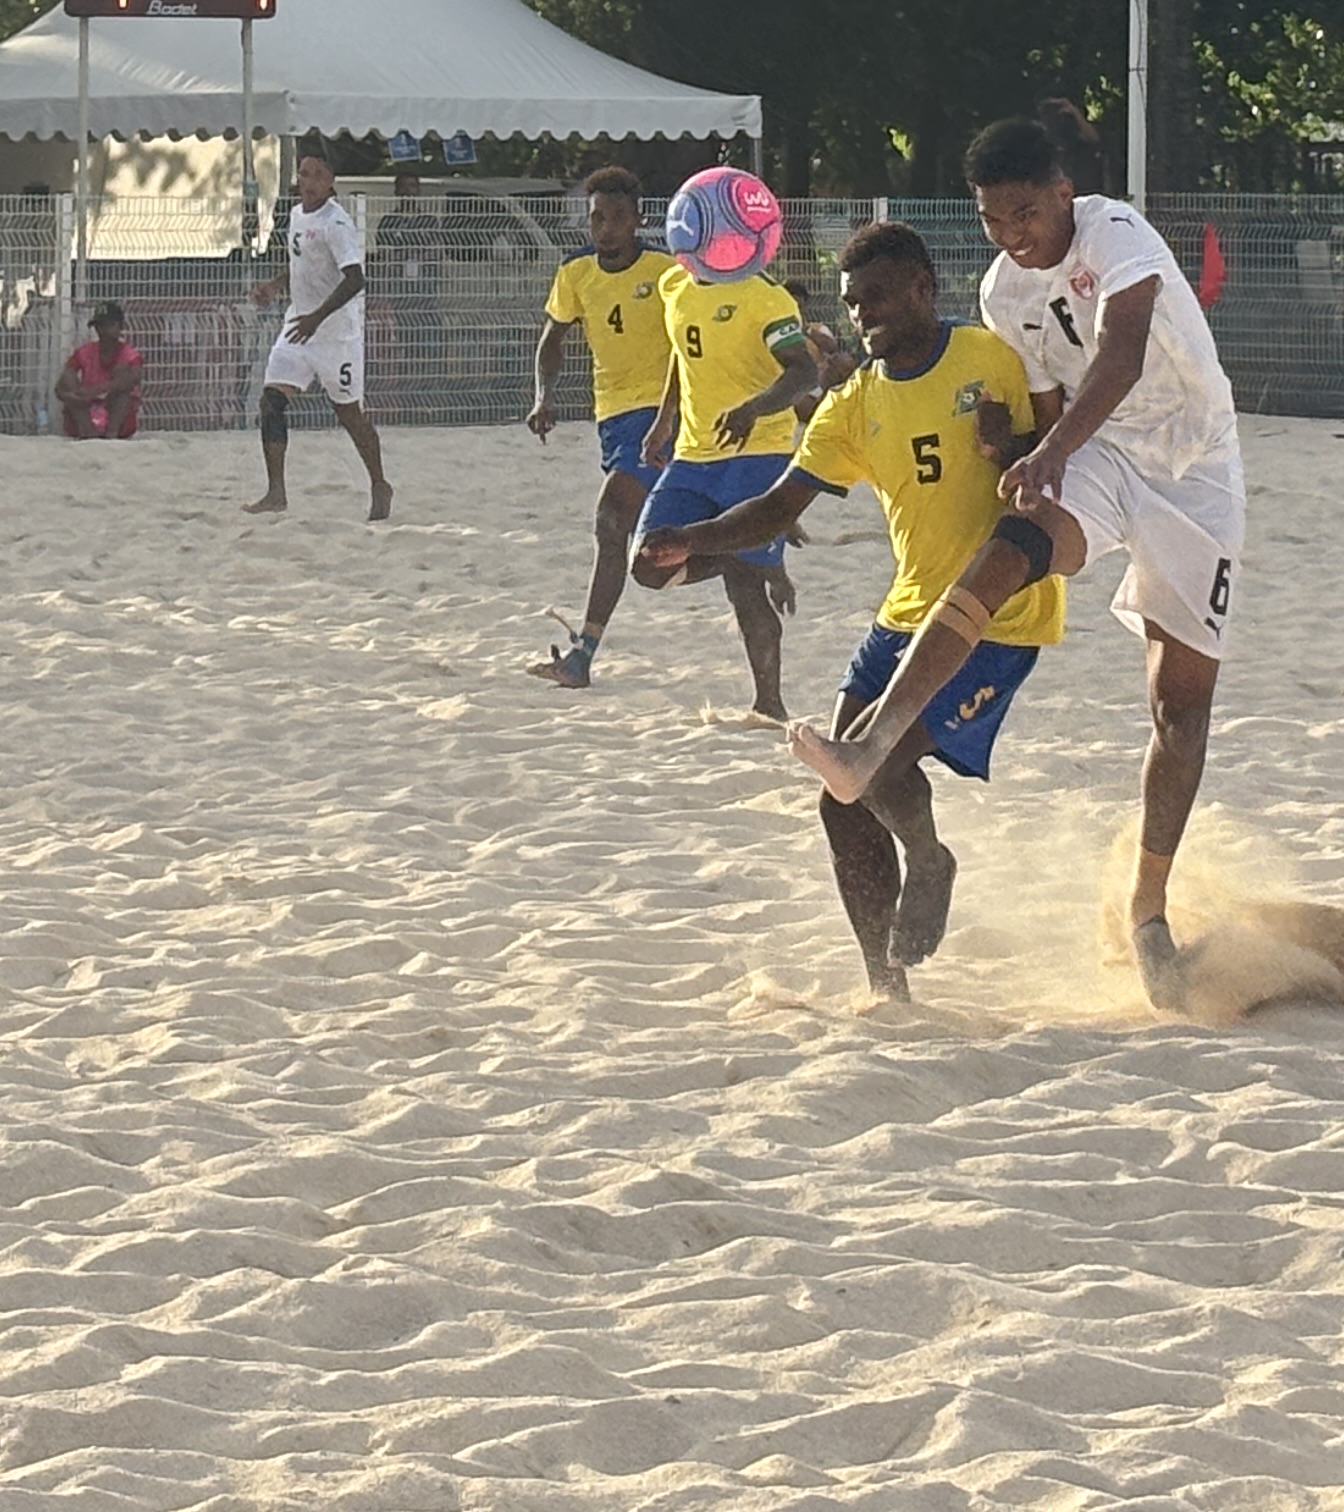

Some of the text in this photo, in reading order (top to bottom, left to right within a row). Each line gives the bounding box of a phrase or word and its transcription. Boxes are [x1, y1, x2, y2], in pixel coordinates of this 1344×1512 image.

[607, 303, 624, 335] 4
[685, 324, 704, 359] 9
[339, 362, 353, 387] 5
[910, 432, 943, 486] 5
[1209, 557, 1232, 617] 6
